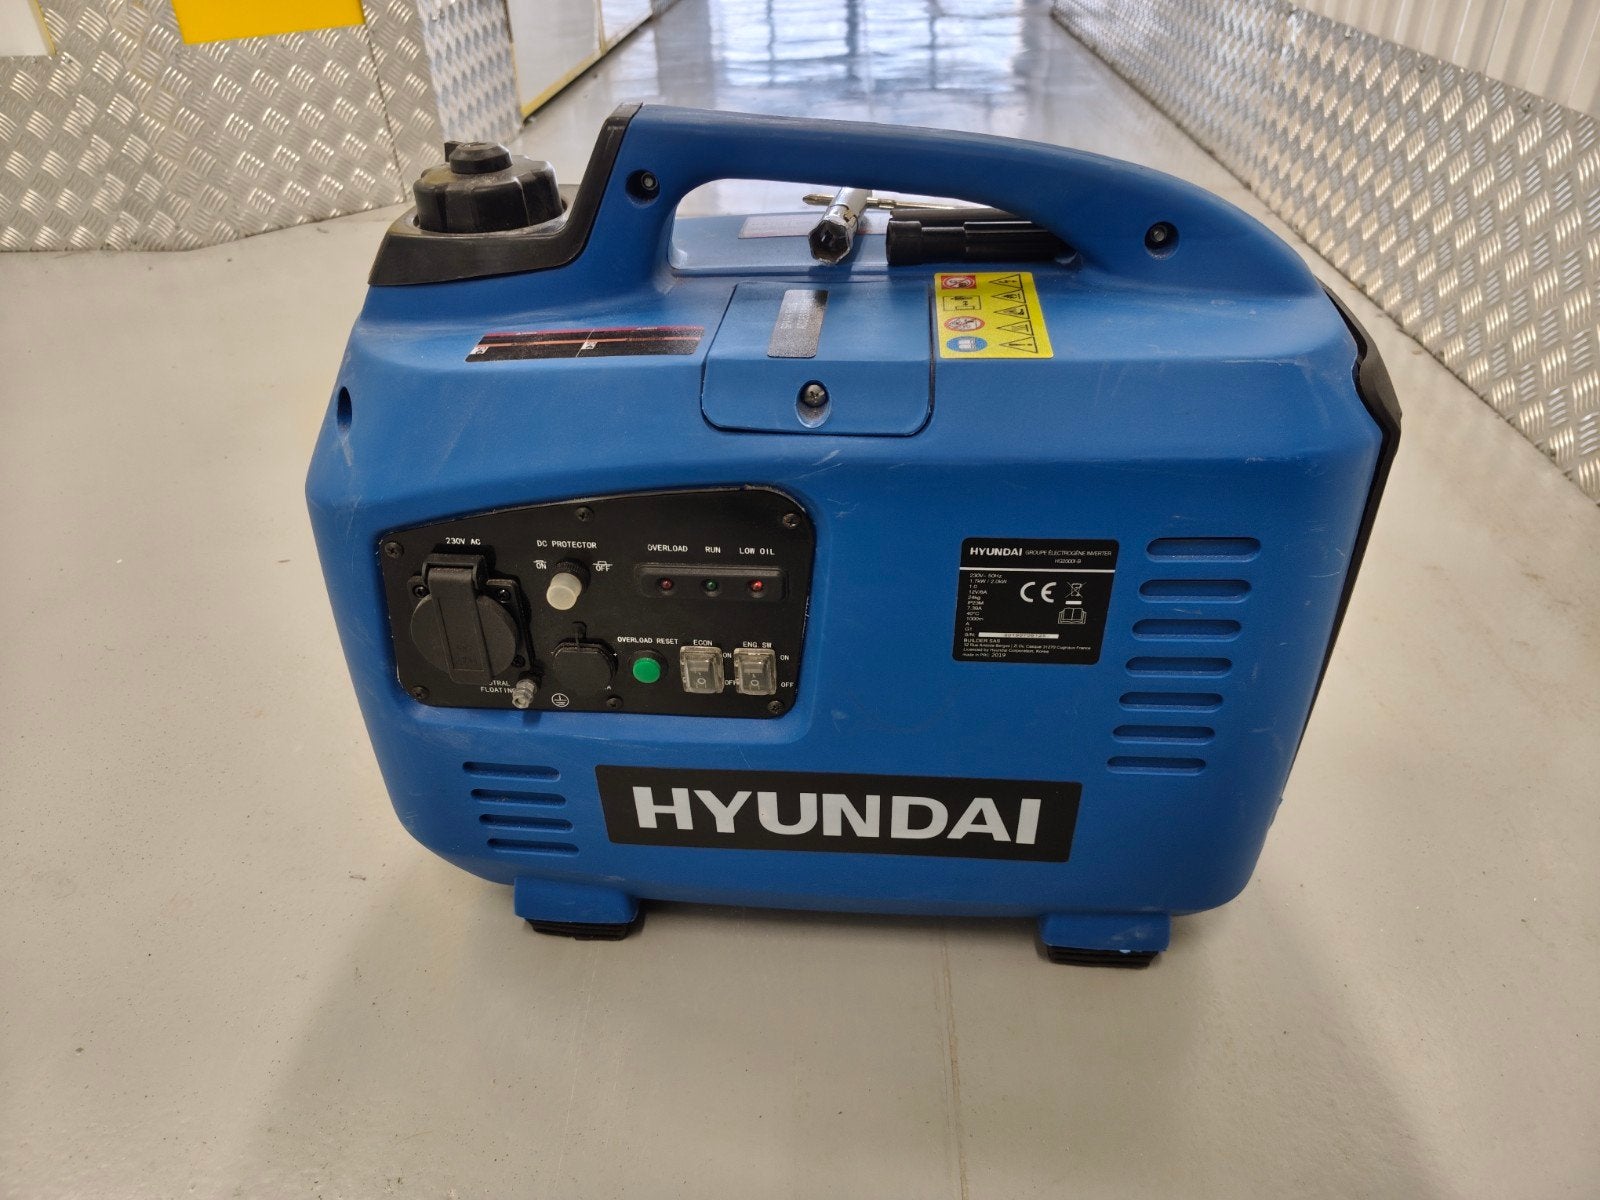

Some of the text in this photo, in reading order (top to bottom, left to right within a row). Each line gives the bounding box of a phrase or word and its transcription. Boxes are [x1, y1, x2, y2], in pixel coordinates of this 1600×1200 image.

[445, 537, 481, 546] 230V AC
[536, 540, 598, 549] DC PROTECTOR
[647, 543, 689, 553] OVERLOAD
[704, 546, 721, 554] RUN
[739, 547, 776, 556] LOW OIL
[969, 547, 1023, 557] HYUNDAI
[535, 562, 547, 570] ON
[595, 563, 611, 572] OFF
[617, 636, 679, 645] OVERLOAD RESET
[692, 638, 713, 647] ECON
[761, 641, 772, 649] SW
[632, 785, 1042, 845] HYUNDAI
